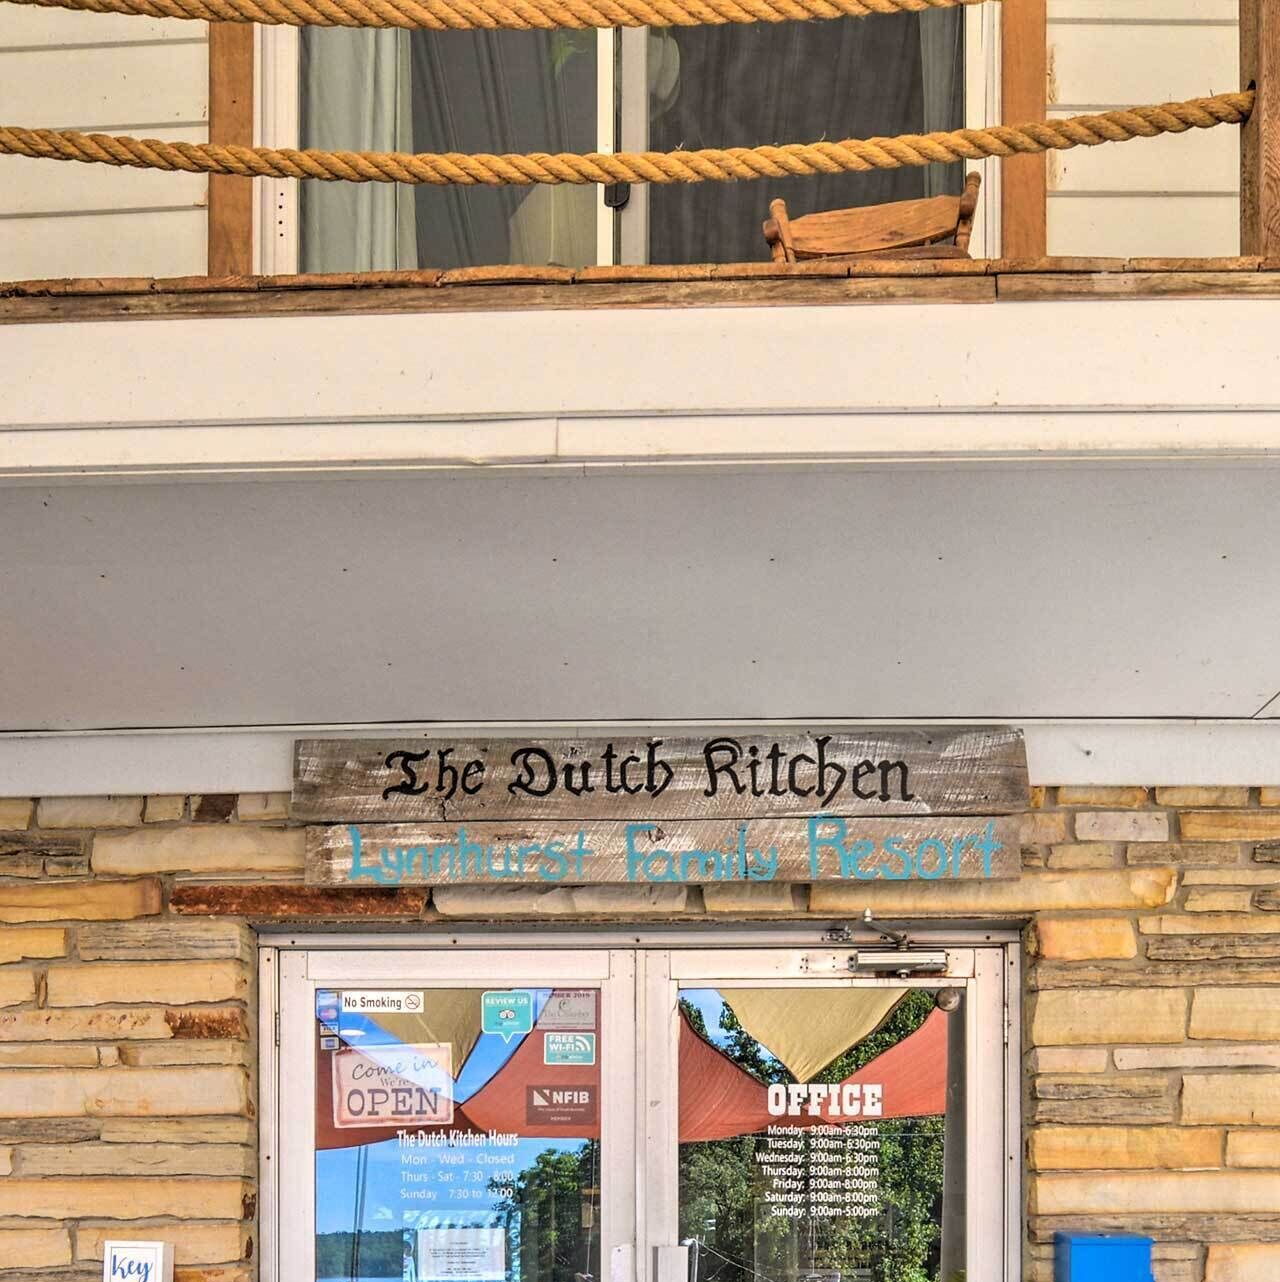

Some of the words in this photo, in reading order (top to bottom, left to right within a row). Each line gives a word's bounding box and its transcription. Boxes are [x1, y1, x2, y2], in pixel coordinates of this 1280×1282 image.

[382, 748, 485, 800] The
[508, 740, 674, 797] Dutch
[703, 736, 915, 807] Kitchen
[348, 823, 594, 885] Lynnhurst
[625, 823, 778, 882] Family
[807, 812, 1003, 880] Resort
[344, 997, 358, 1008] No
[360, 996, 402, 1010] Smoking
[548, 1035, 575, 1043] FREE
[346, 1086, 441, 1117] OPEN
[552, 1091, 589, 1104] NFIB
[767, 1083, 882, 1116] OFFICE
[397, 1130, 417, 1147] The
[418, 1130, 447, 1147] Dutch
[450, 1129, 487, 1147] Kitchen
[489, 1130, 519, 1147] Hours
[401, 1154, 427, 1165] Mon
[439, 1153, 464, 1165] Wed
[476, 1153, 514, 1165] Closed
[401, 1171, 428, 1182] Thurs
[438, 1171, 454, 1182] Sat
[463, 1171, 483, 1182] 7:30
[400, 1188, 437, 1200] Sunday
[449, 1188, 469, 1199] 7:30
[472, 1189, 482, 1198] to
